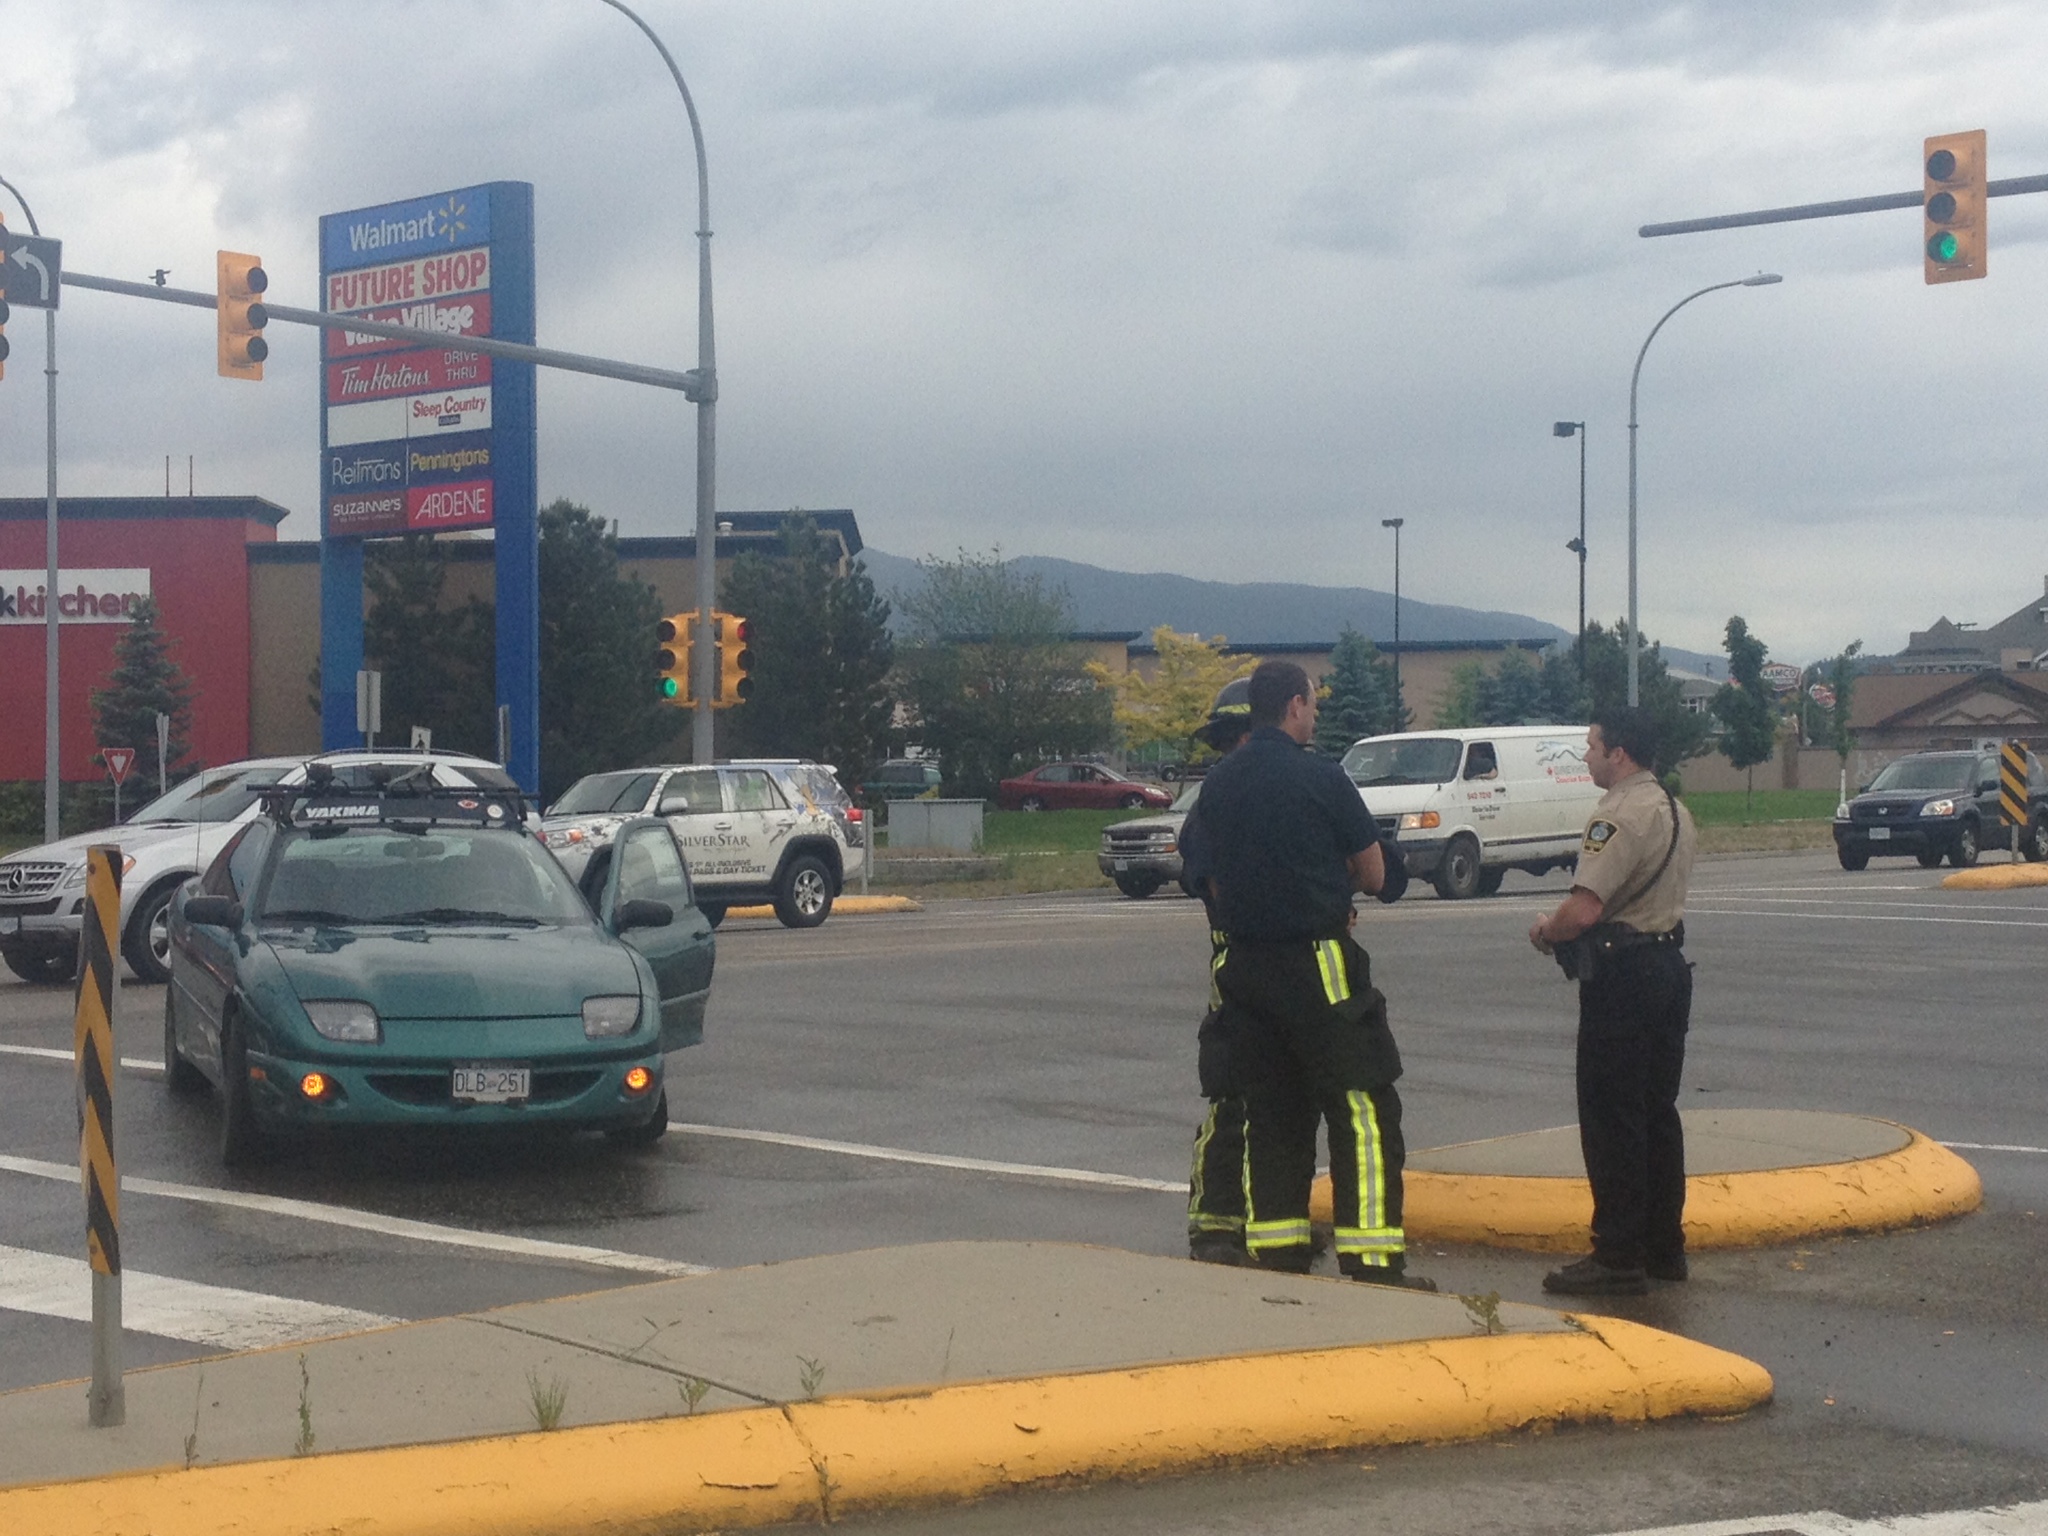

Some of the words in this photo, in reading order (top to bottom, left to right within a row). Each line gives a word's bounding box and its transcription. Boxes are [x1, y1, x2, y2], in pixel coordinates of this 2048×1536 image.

[350, 210, 435, 251] Walmart
[330, 264, 415, 310] FUTURE
[422, 252, 487, 295] SHOP
[401, 303, 474, 335] Village
[444, 351, 478, 365] DRIVE
[342, 365, 369, 395] Tim
[370, 362, 429, 391] Hortons
[445, 366, 477, 381] THRU
[413, 400, 442, 418] Sleep
[444, 395, 486, 413] Country
[332, 456, 400, 485] Reitmans
[410, 448, 489, 473] Penningtons
[415, 488, 486, 520] ARDENE
[0, 584, 141, 617] kkichen
[305, 804, 380, 818] YAKIMA
[741, 865, 766, 873] TICKET
